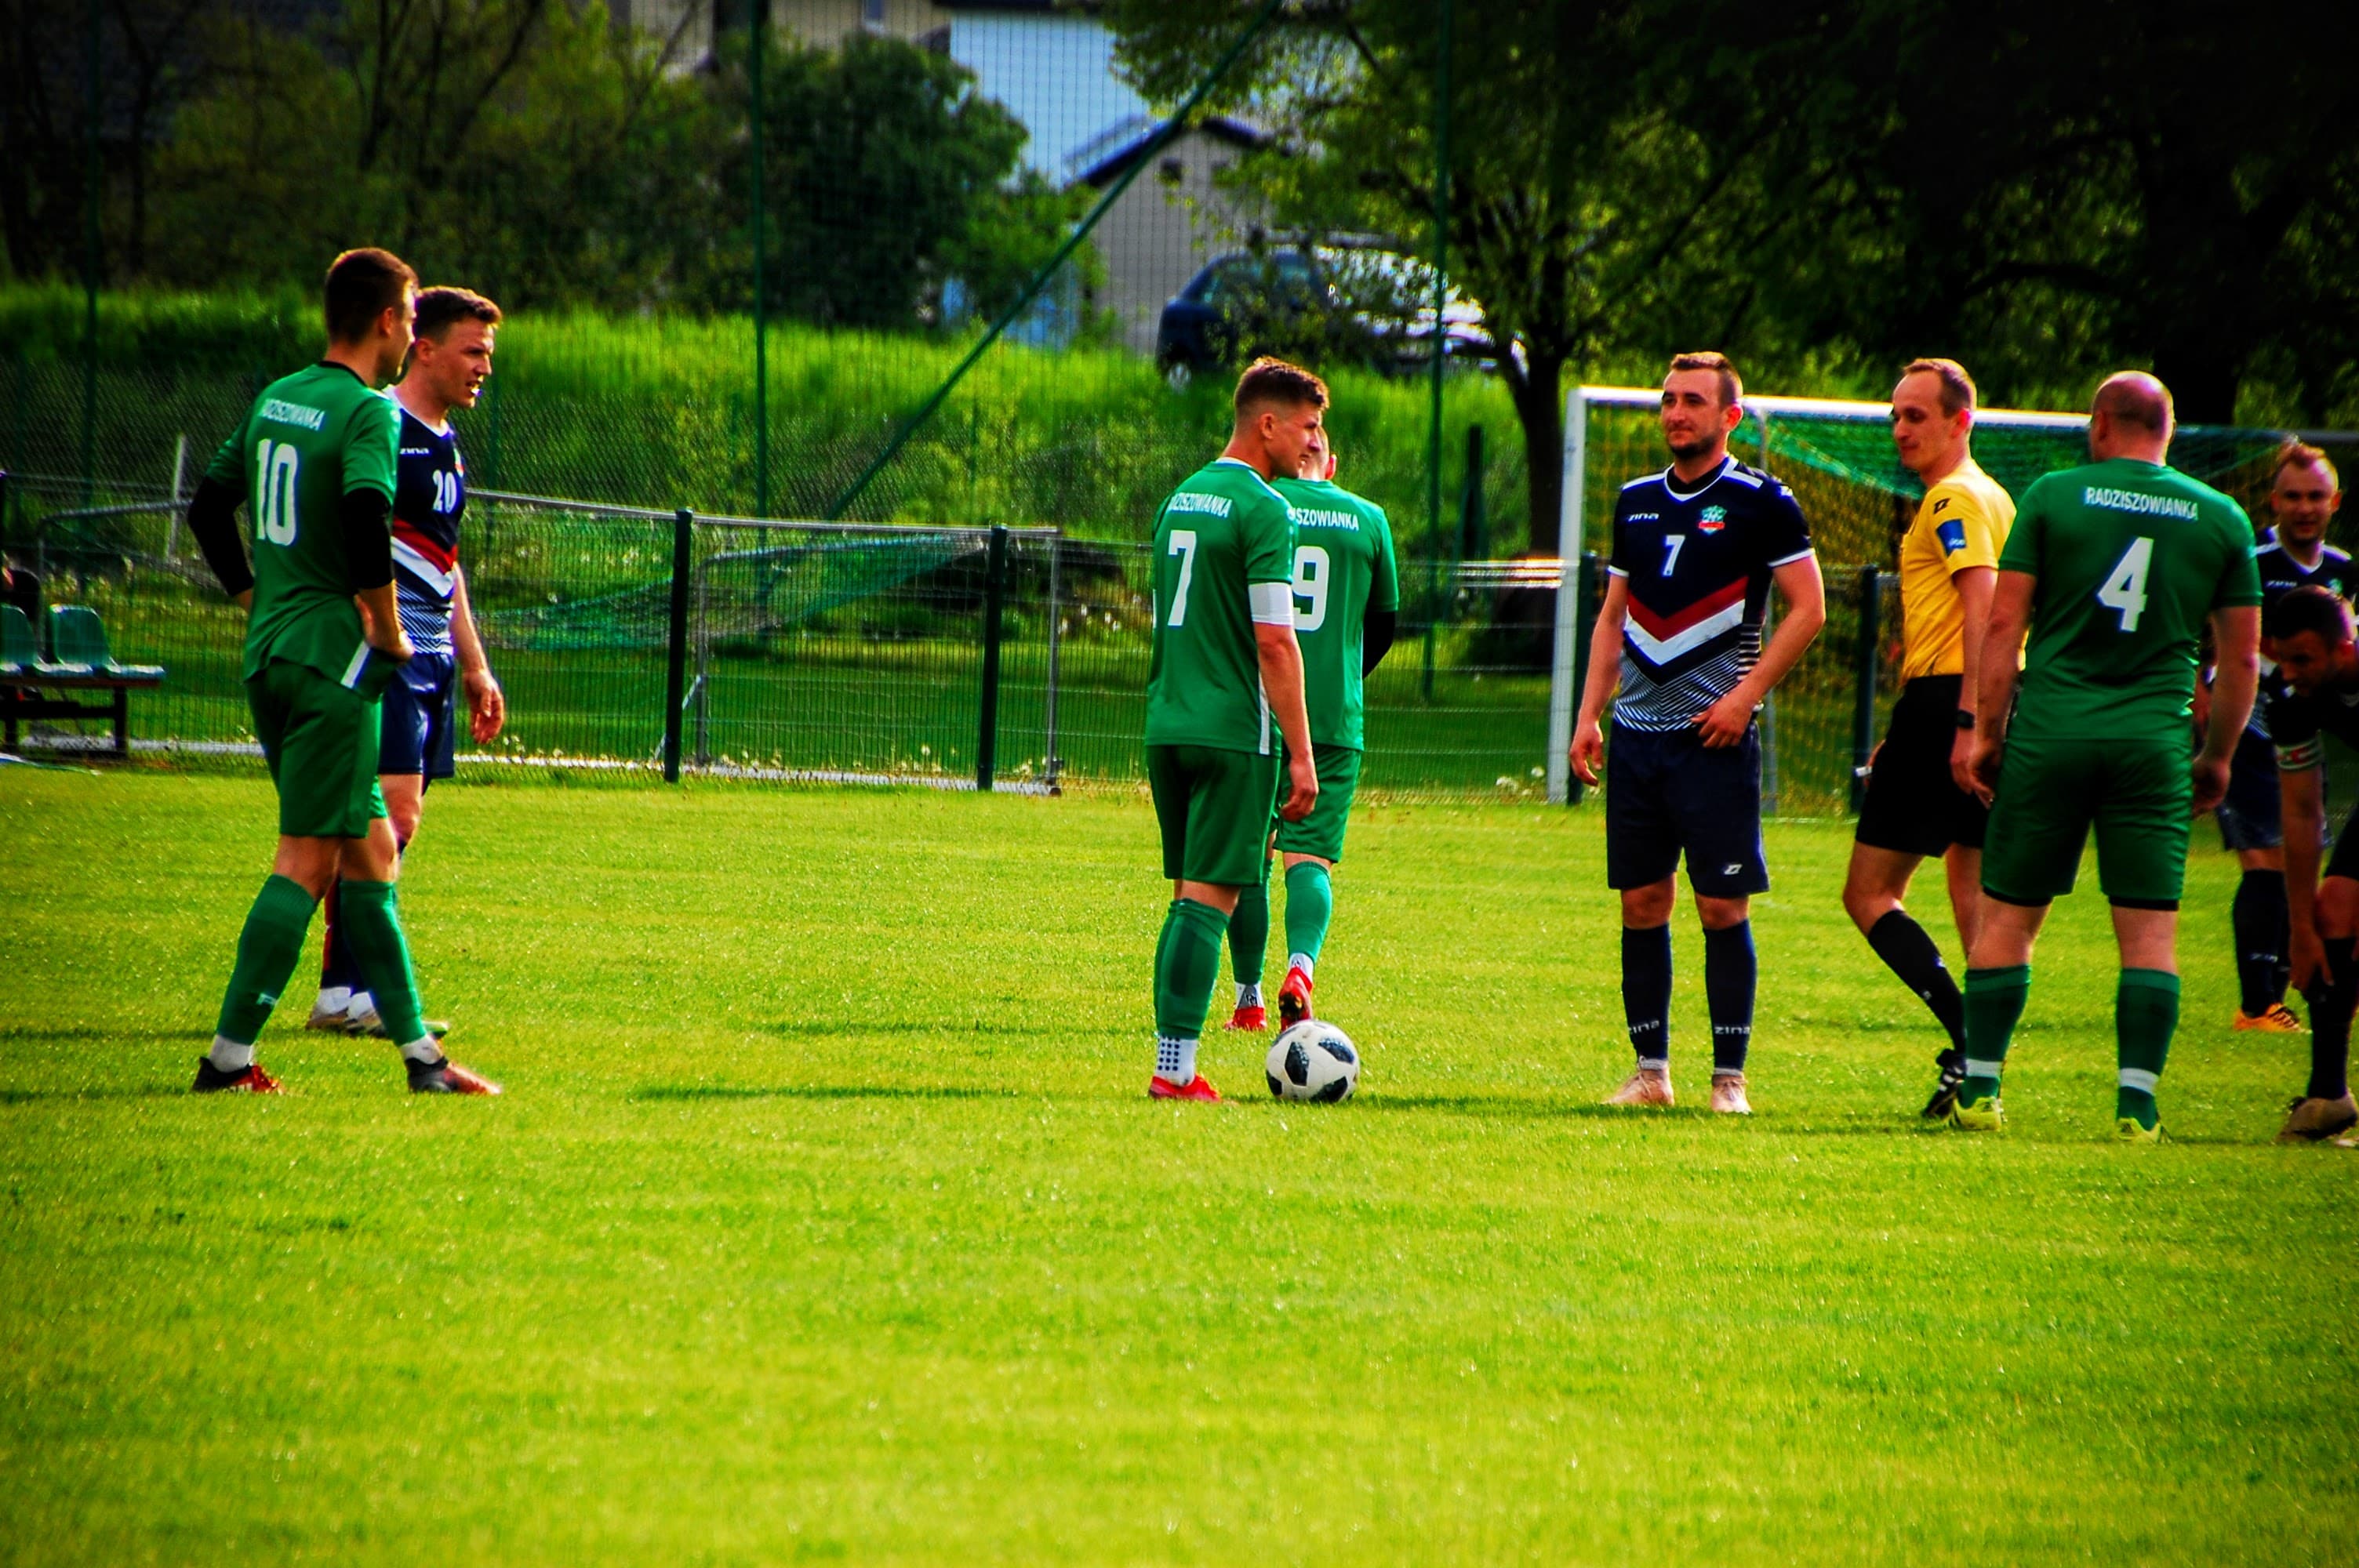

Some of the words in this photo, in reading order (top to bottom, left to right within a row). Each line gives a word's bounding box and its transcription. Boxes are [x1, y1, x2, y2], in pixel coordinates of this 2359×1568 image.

[256, 438, 297, 546] 10
[432, 470, 456, 513] 20
[2085, 486, 2198, 521] RADZISZOWIANKA
[1168, 530, 1197, 626] 7
[1292, 546, 1330, 631] 9
[1663, 535, 1685, 575] 7
[2097, 536, 2154, 632] 4
